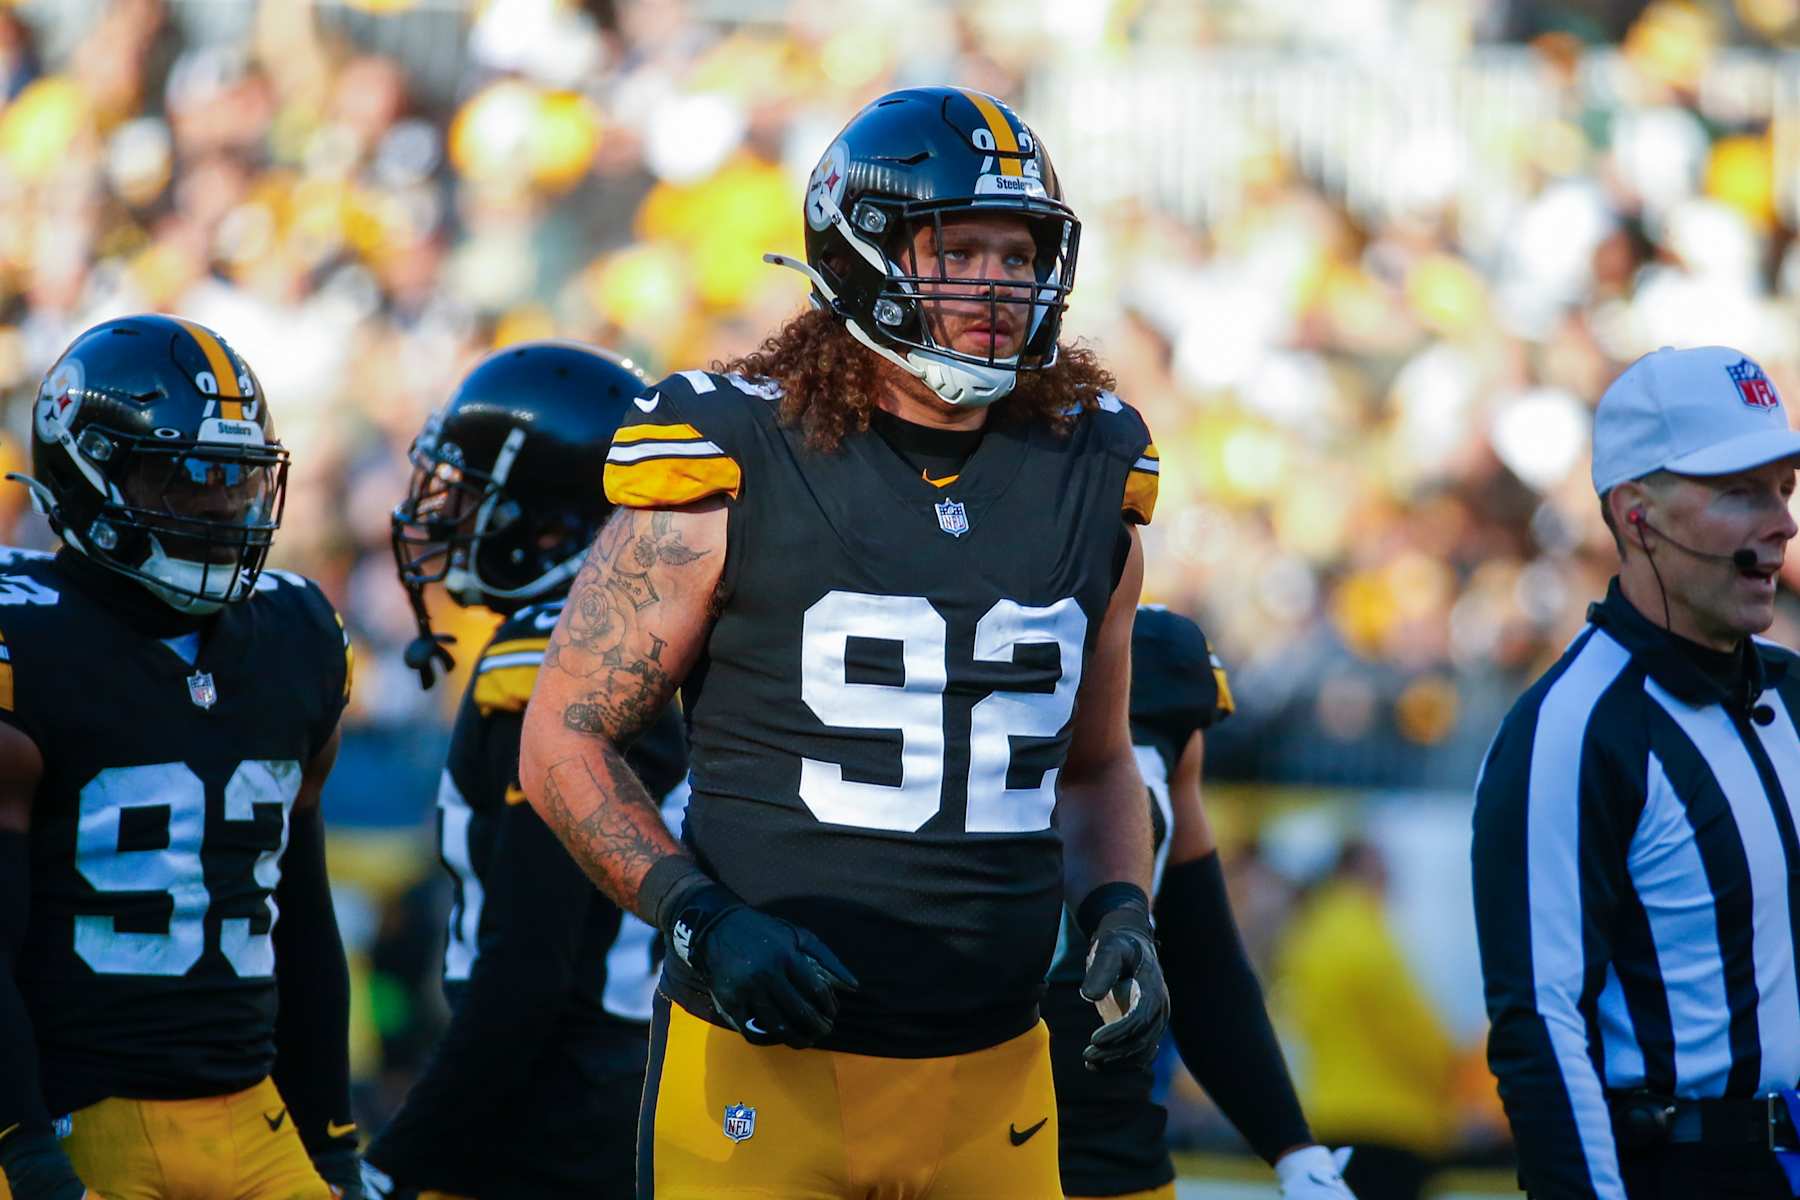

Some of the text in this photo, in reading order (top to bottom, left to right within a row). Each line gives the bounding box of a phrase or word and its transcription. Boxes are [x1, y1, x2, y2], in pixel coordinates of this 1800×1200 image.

[1737, 381, 1777, 405] NFL
[799, 590, 1088, 833] 92
[73, 760, 303, 978] 93
[726, 1118, 750, 1136] NFL
